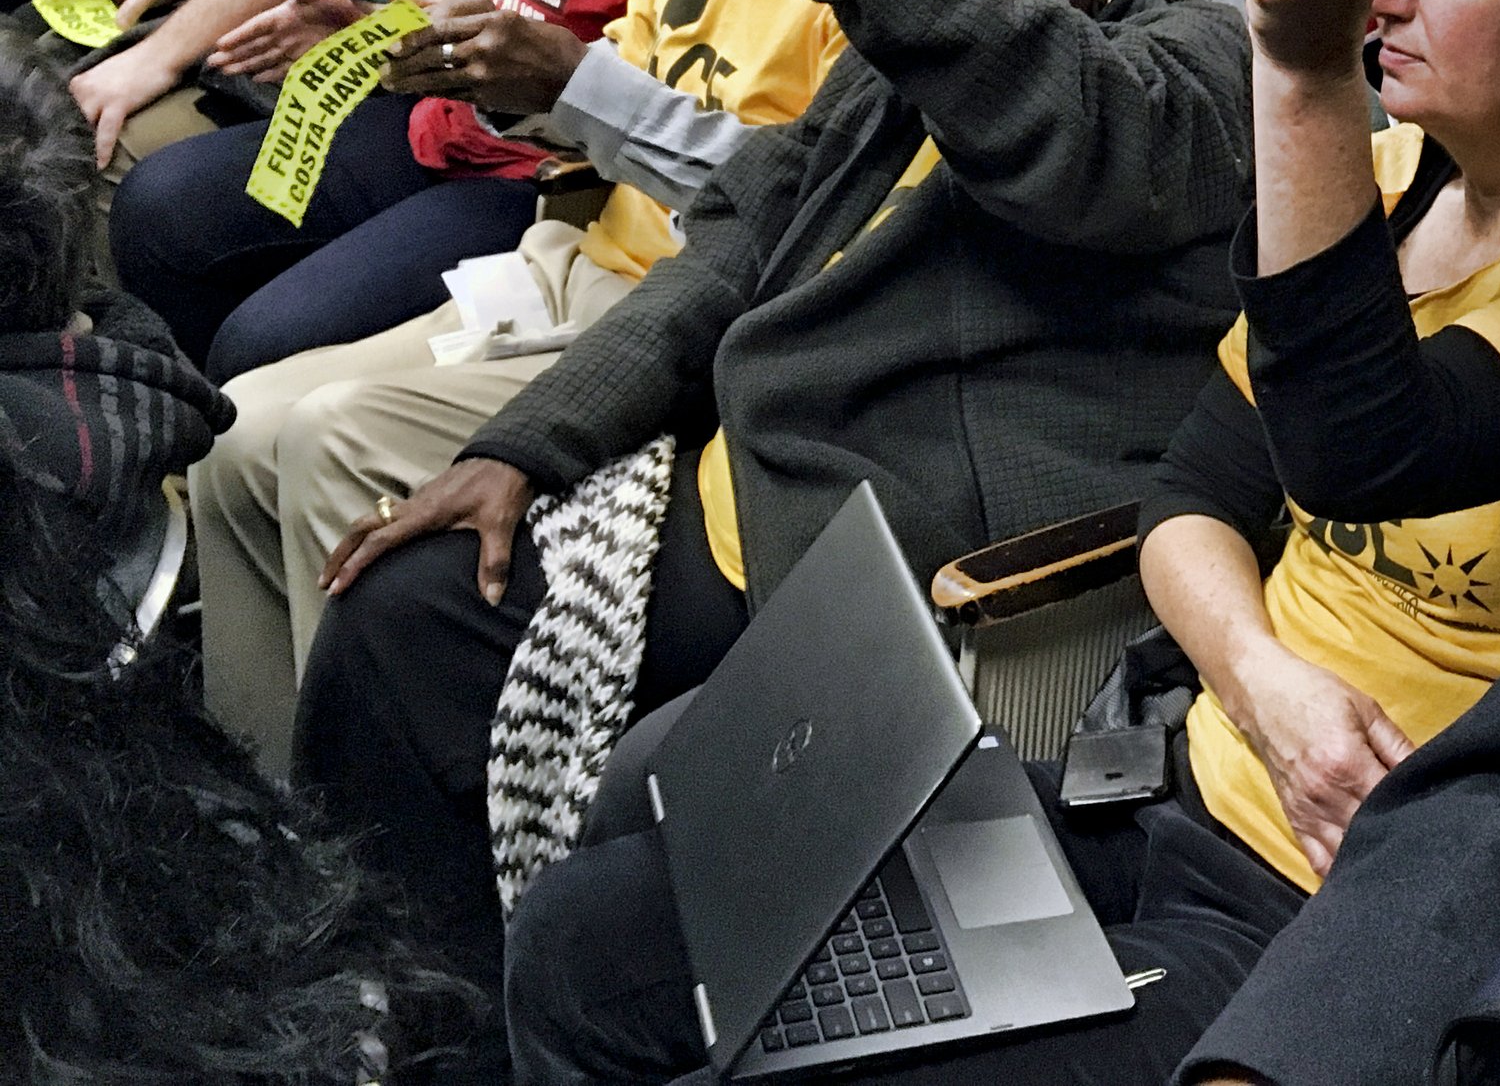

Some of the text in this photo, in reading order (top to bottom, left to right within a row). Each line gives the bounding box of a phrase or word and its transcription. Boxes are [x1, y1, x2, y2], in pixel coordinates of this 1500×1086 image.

[267, 23, 400, 178] FULLY REPEAL
[290, 48, 394, 204] COSTA-HAWKI
